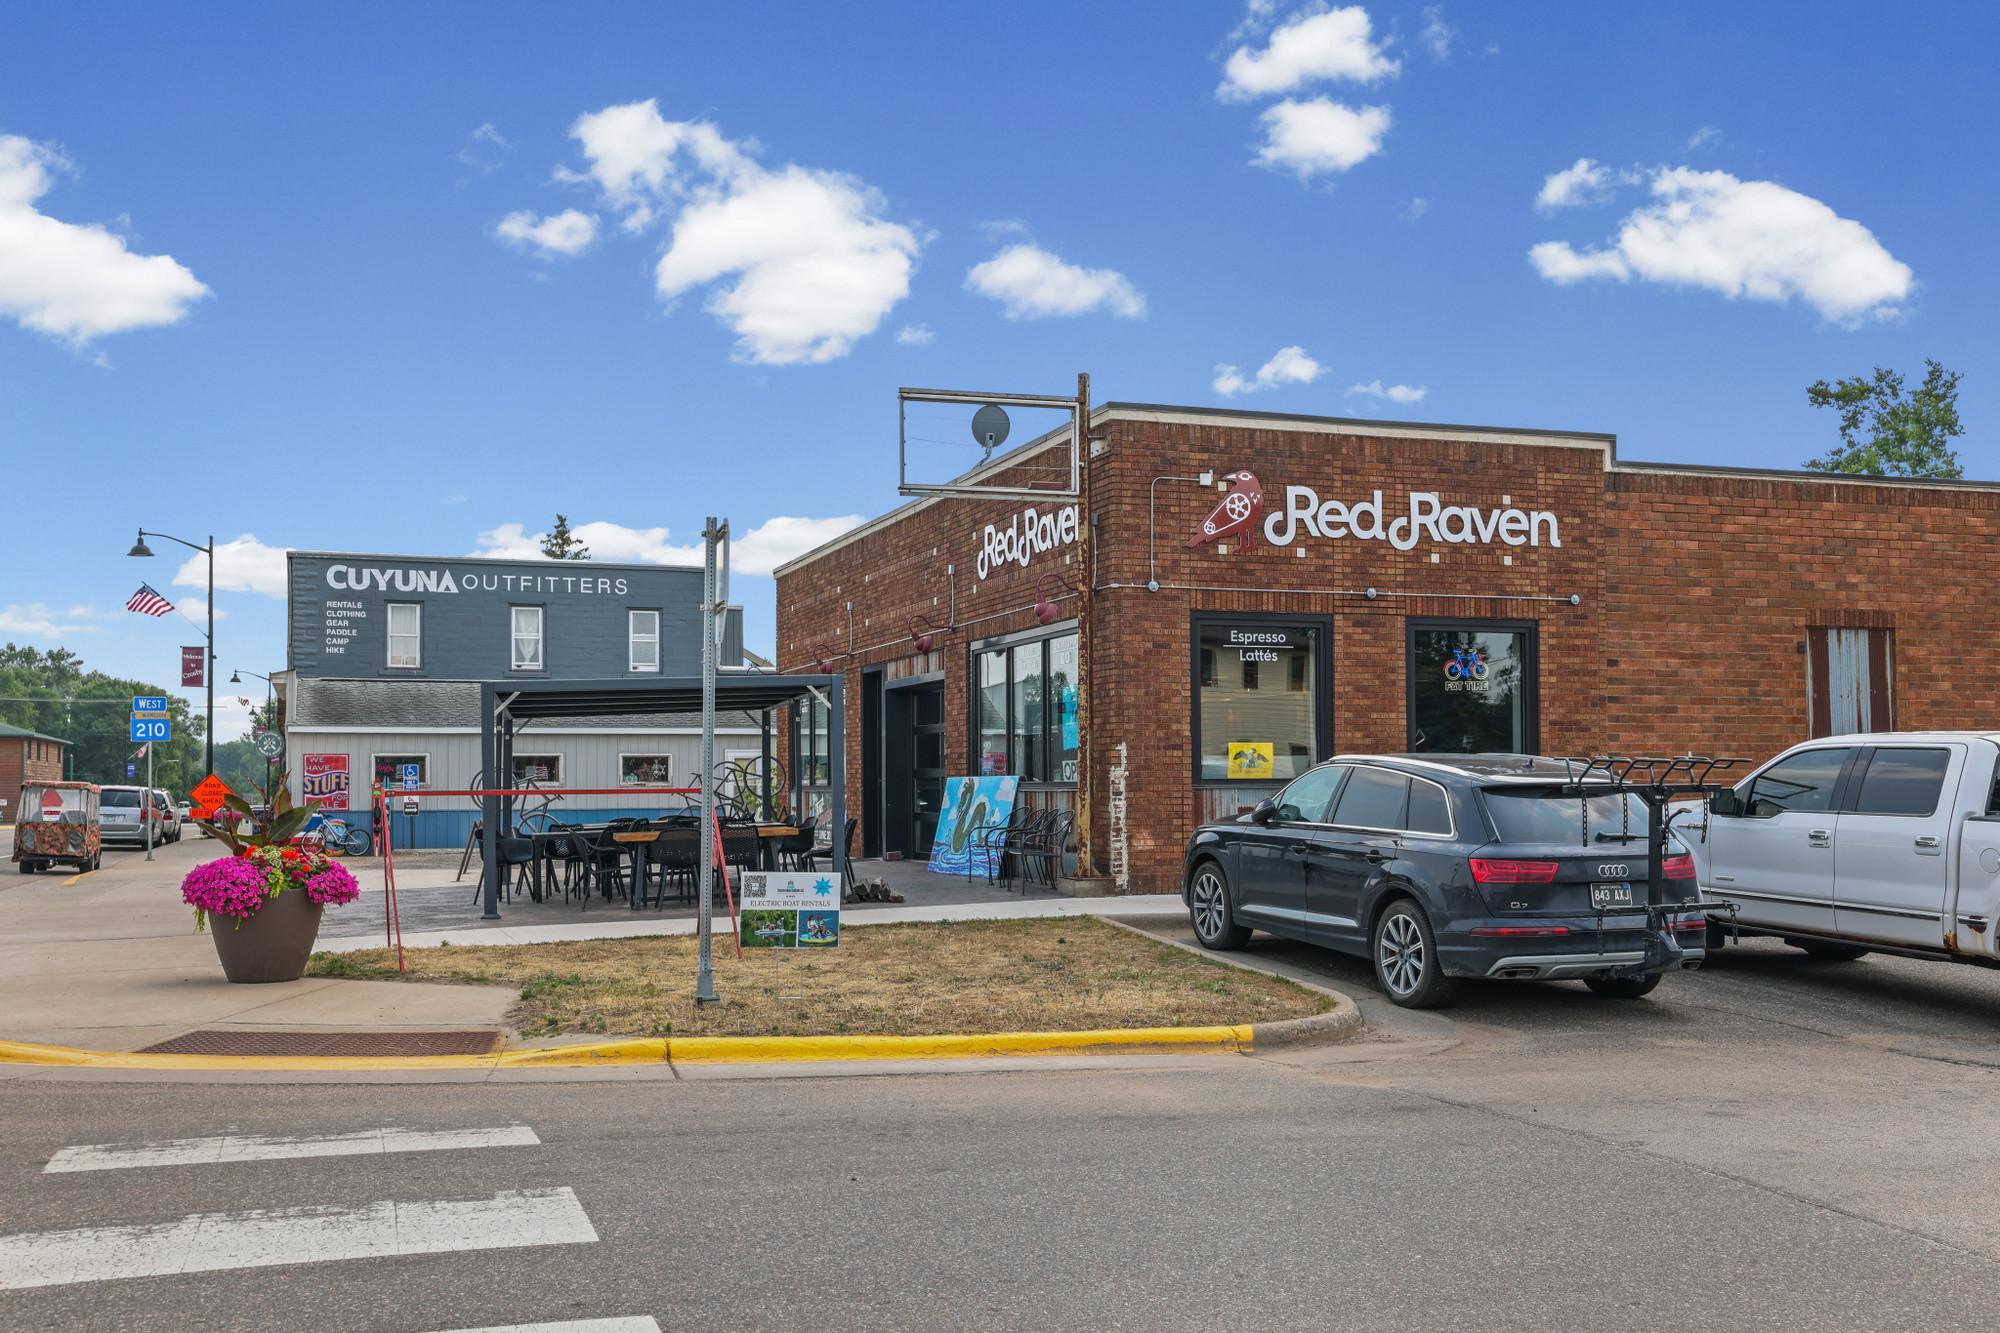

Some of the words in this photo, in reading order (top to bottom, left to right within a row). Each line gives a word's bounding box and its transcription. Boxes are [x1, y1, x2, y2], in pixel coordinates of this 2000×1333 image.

[1264, 485, 1386, 546] Red
[1388, 491, 1561, 551] Raven
[977, 513, 1018, 580] Red
[326, 564, 460, 594] CUYUNA
[462, 574, 628, 595] OUTFITTERS
[326, 601, 363, 609] RENTALS
[326, 610, 367, 618] CLOTHING
[326, 619, 349, 627] GEAR
[326, 628, 358, 636] PADDLE
[1230, 630, 1287, 645] Espresso
[326, 637, 349, 645] CAMP
[326, 646, 345, 654] HIKE
[1240, 649, 1278, 662] Lattés
[1444, 680, 1464, 691] FAT
[1464, 680, 1489, 691] TIRE
[138, 698, 162, 709] WEST
[136, 723, 165, 737] 210
[304, 773, 348, 795] STUFF
[1594, 889, 1610, 901] 843
[1614, 888, 1630, 901] AXJ
[1510, 901, 1528, 909] Q7
